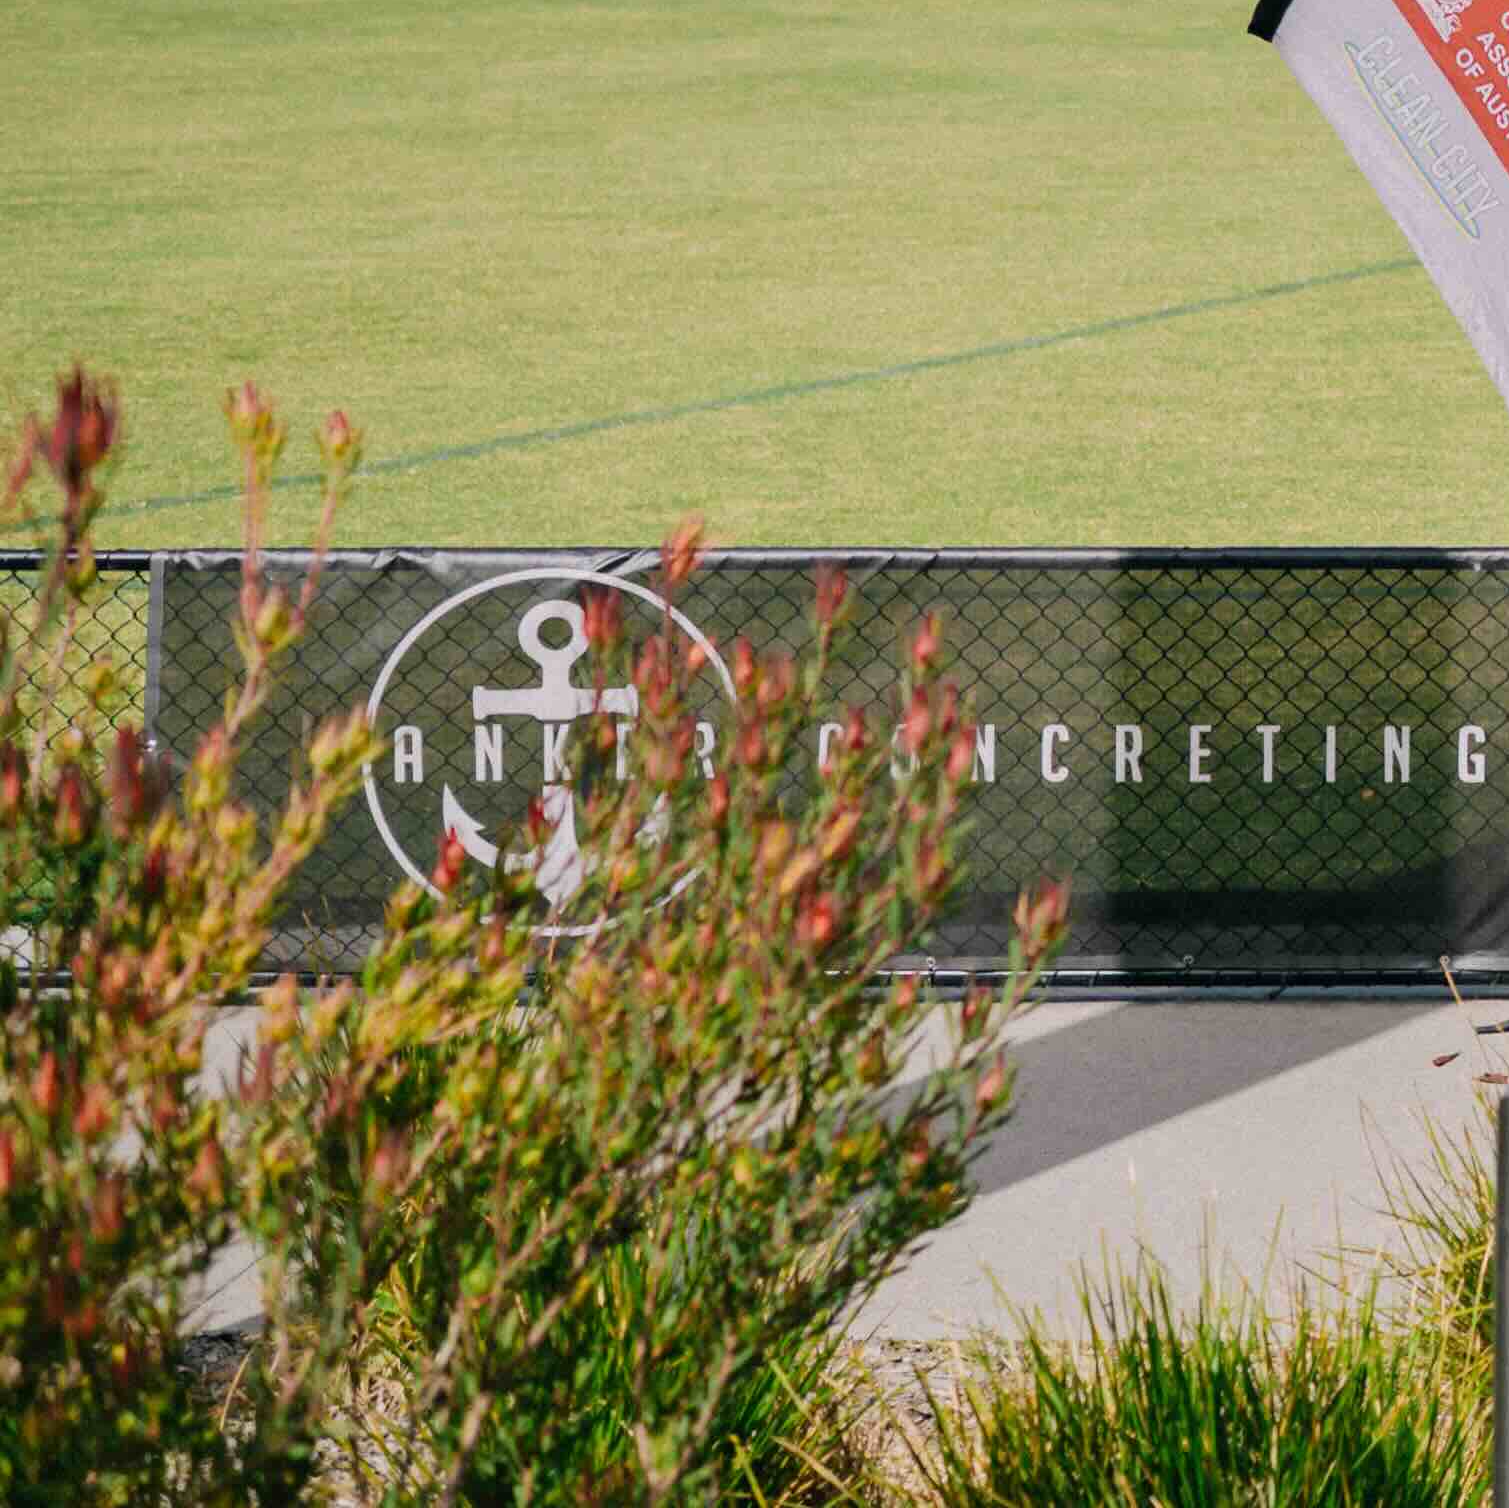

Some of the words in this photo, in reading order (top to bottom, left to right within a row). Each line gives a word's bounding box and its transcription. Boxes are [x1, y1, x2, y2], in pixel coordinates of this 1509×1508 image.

[1455, 48, 1485, 78] OF
[1357, 35, 1450, 148] CLEAN
[1431, 143, 1501, 221] CITY
